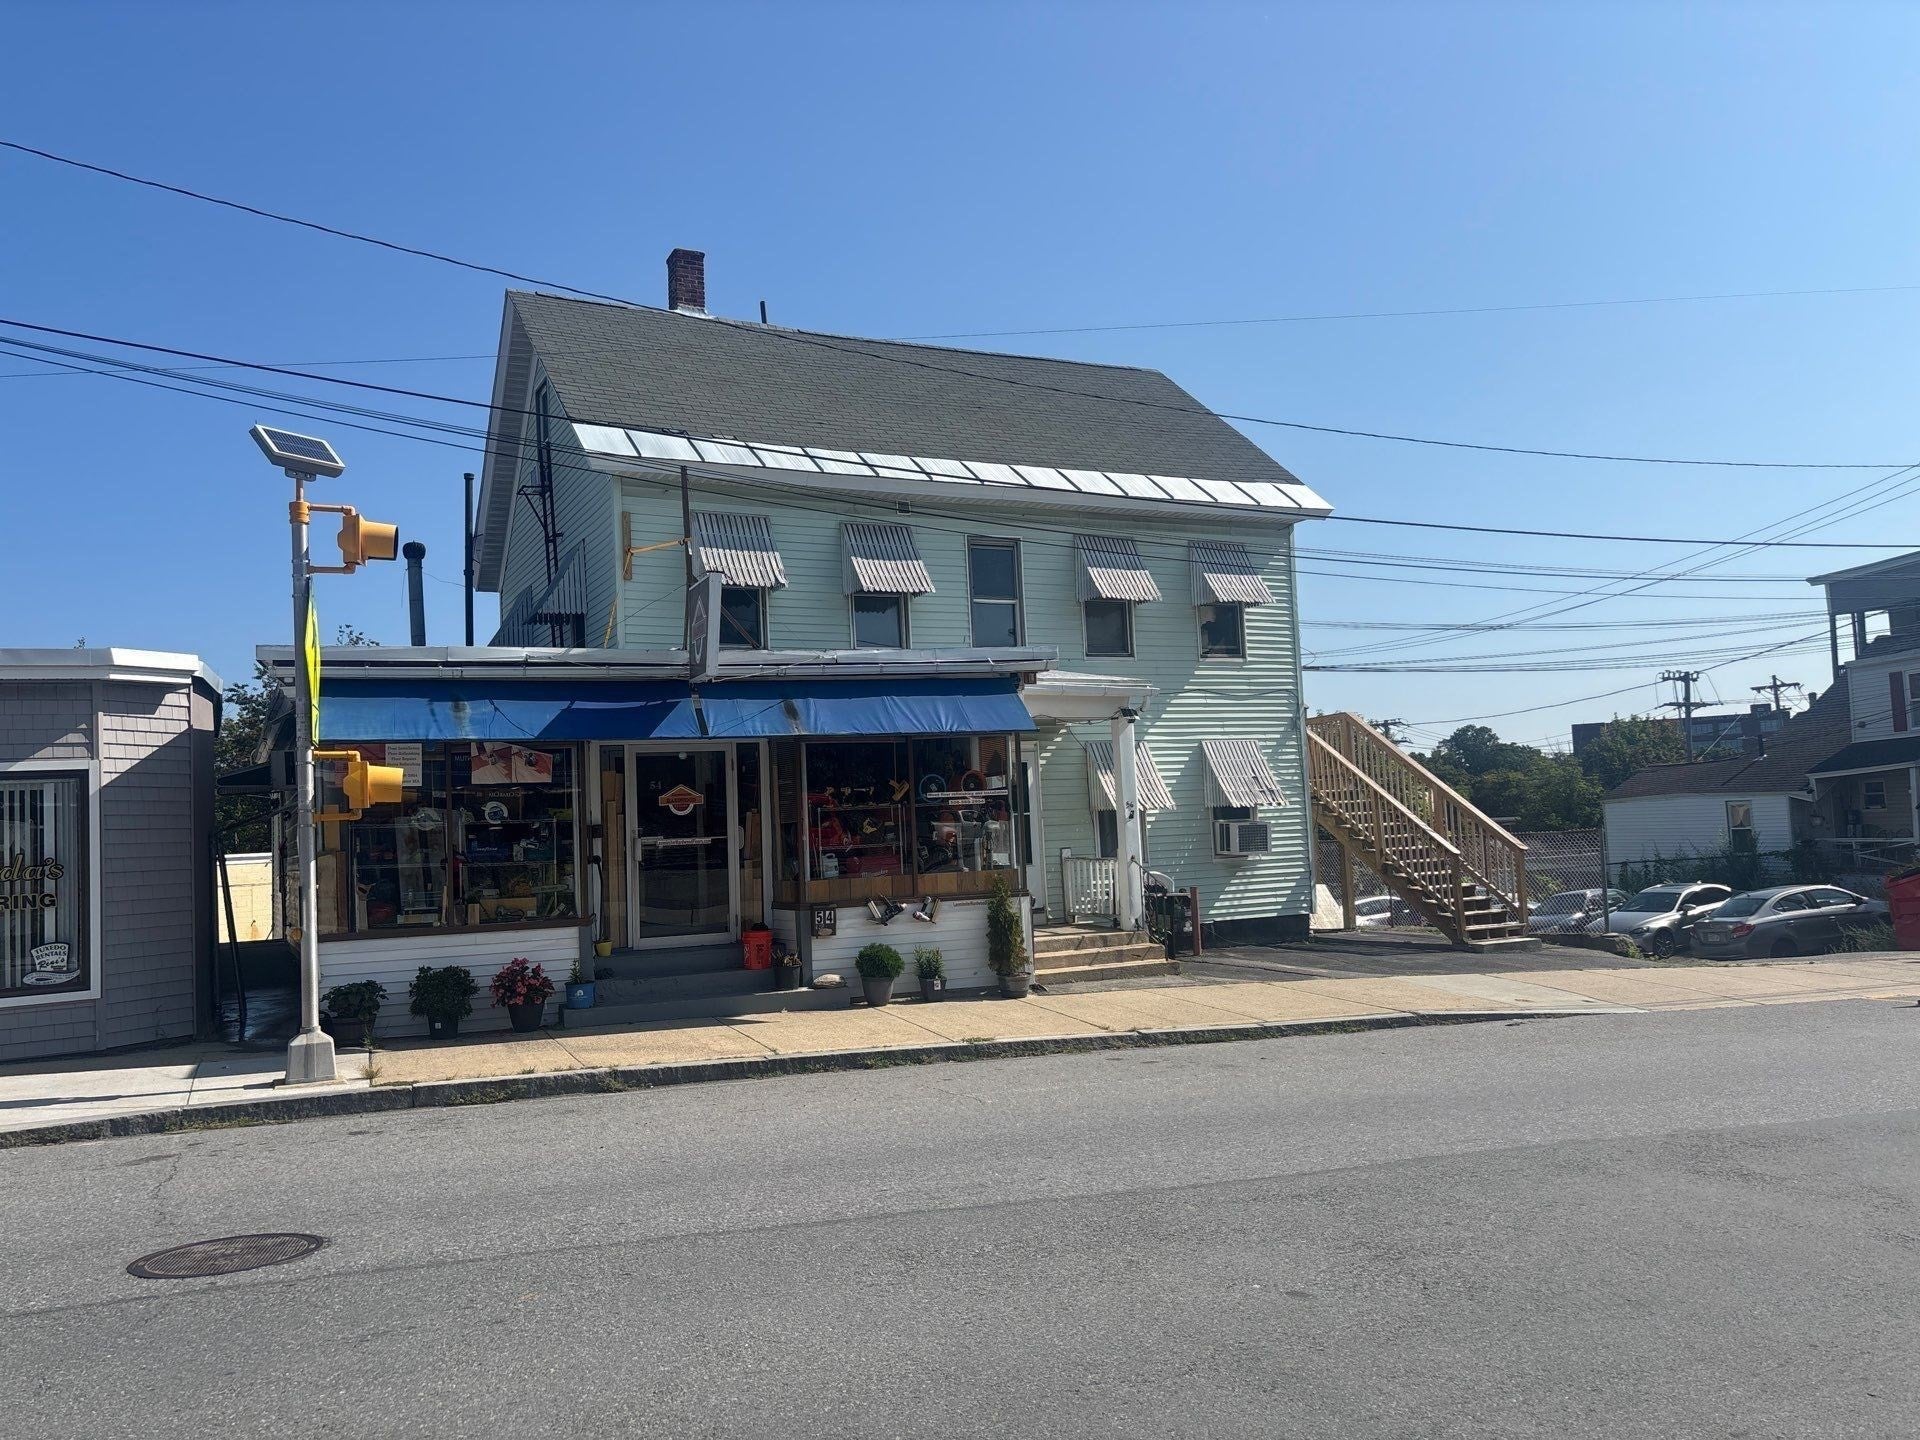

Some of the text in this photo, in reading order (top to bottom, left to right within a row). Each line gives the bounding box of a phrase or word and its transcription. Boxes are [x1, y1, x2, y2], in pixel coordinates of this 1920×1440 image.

[816, 911, 833, 924] 54
[34, 945, 66, 955] TUXEDO
[35, 951, 67, 961] RENTALS
